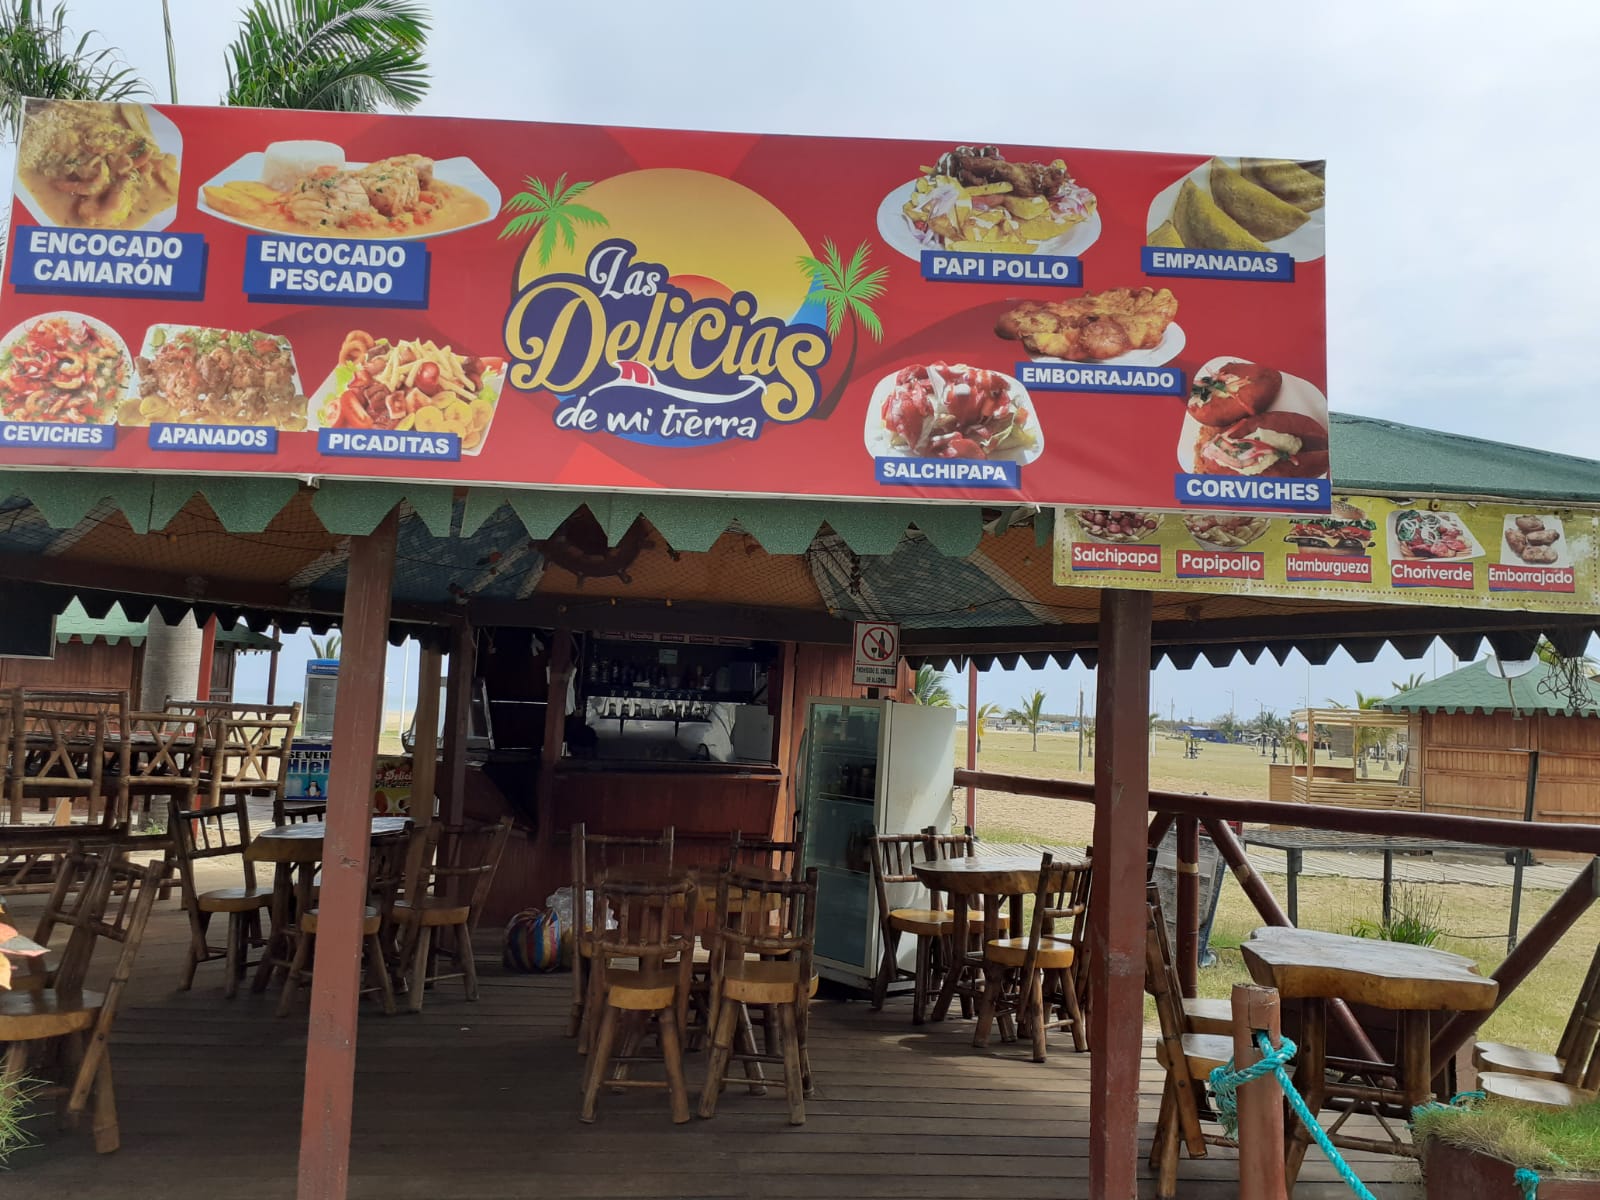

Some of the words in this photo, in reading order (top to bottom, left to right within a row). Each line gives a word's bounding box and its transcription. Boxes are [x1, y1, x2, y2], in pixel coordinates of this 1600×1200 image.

[29, 231, 184, 259] ENCOCADO
[260, 240, 407, 268] ENCOCADO
[33, 258, 173, 286] CAMARÓN
[588, 246, 662, 300] Las
[932, 257, 985, 277] PAPI
[992, 259, 1069, 280] POLLO
[1151, 252, 1279, 273] EMPANADAS
[269, 268, 393, 294] PESCADO
[1021, 367, 1175, 388] EMBORRAJADO
[556, 397, 599, 431] de
[606, 407, 653, 434] mi
[659, 403, 758, 439] tierra
[2, 424, 103, 444] CEVICHES
[157, 427, 269, 447] APANADOS
[328, 433, 450, 455] PICADITAS
[883, 461, 1007, 482] SALCHIPAPA
[1186, 480, 1320, 502] CORVICHES
[1074, 547, 1158, 567] Salchipapa
[1182, 553, 1261, 573] Papipollo
[1287, 557, 1369, 576] Hamburgueza
[1391, 563, 1473, 582] Choriverde
[1488, 567, 1573, 585] Emborrajado
[288, 759, 330, 774] Hiel
